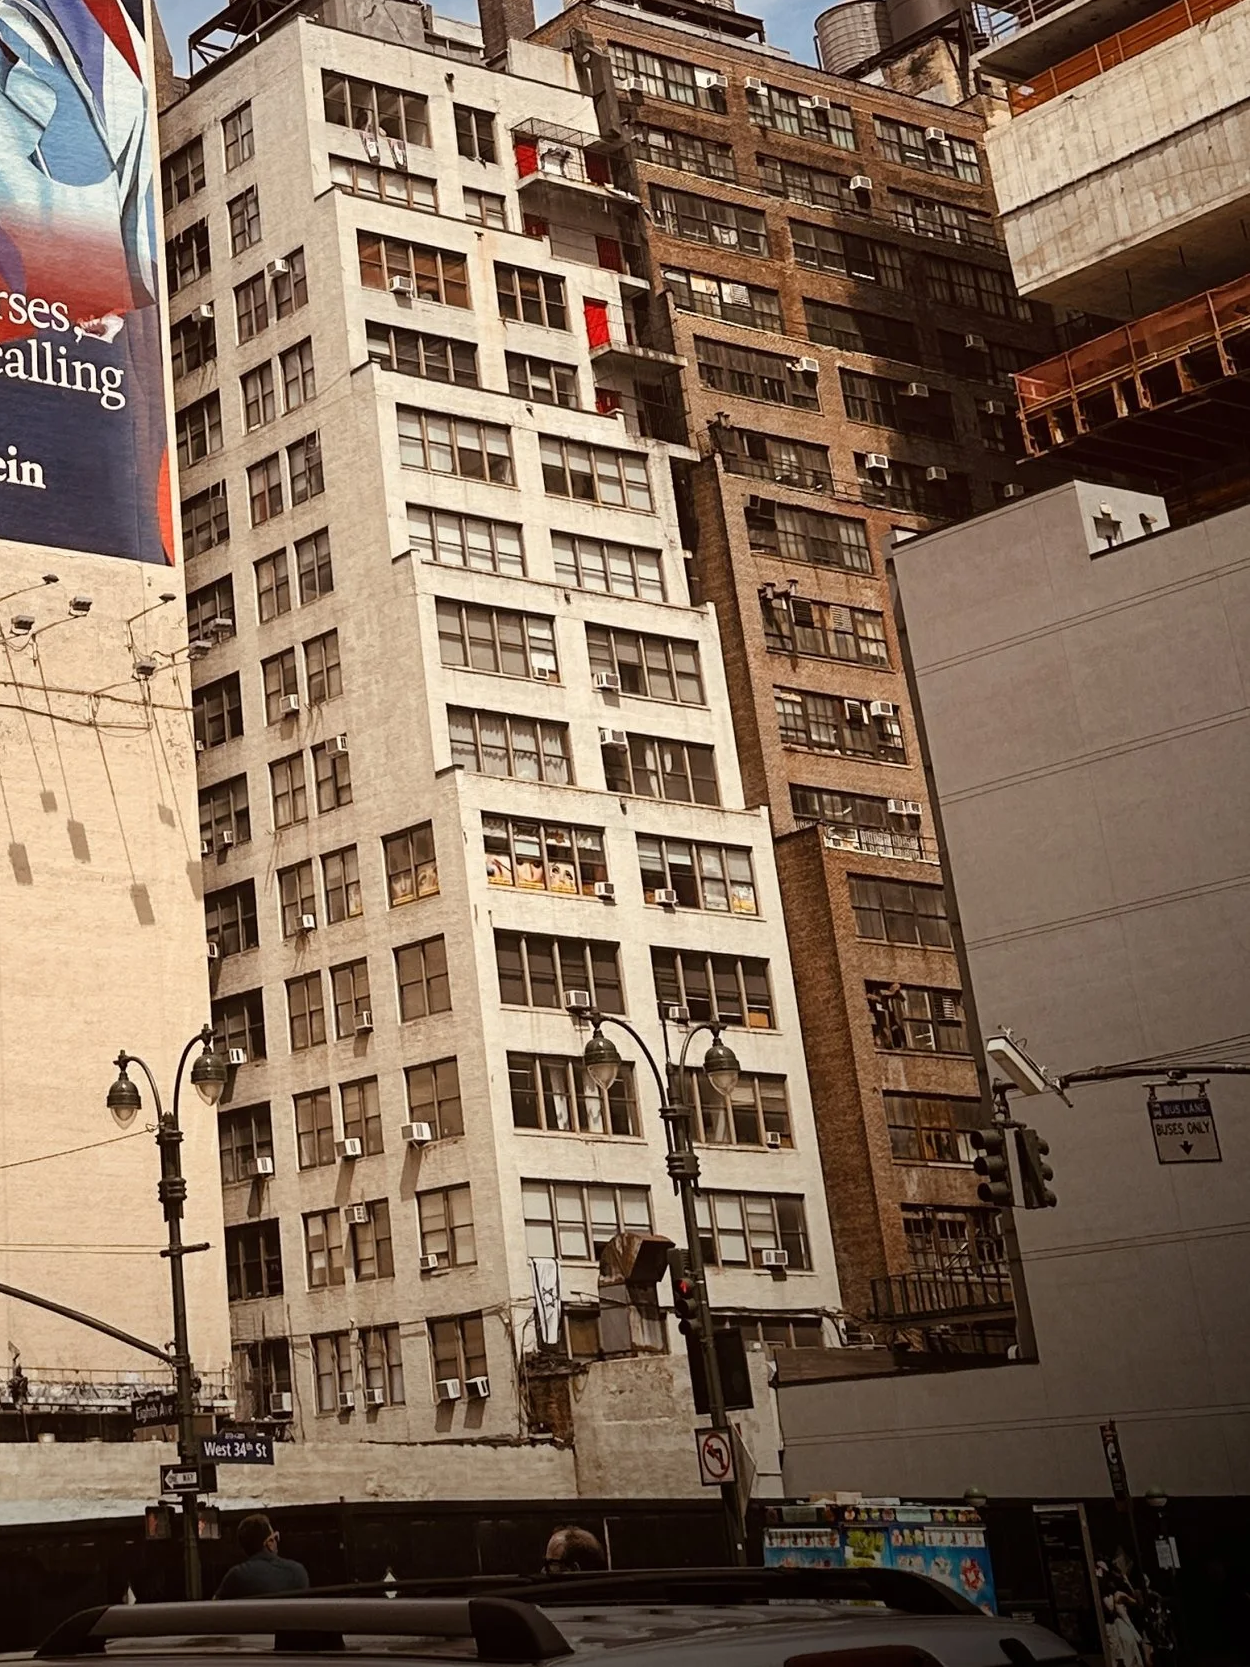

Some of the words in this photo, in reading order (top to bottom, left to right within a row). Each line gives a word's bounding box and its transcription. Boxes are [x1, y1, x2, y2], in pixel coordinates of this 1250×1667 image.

[1163, 1103, 1182, 1115] BUS
[1183, 1101, 1207, 1114] LANE
[1155, 1122, 1185, 1136] BUSES
[1187, 1121, 1210, 1135] ONLY
[203, 1441, 232, 1457] West
[255, 1442, 268, 1458] St
